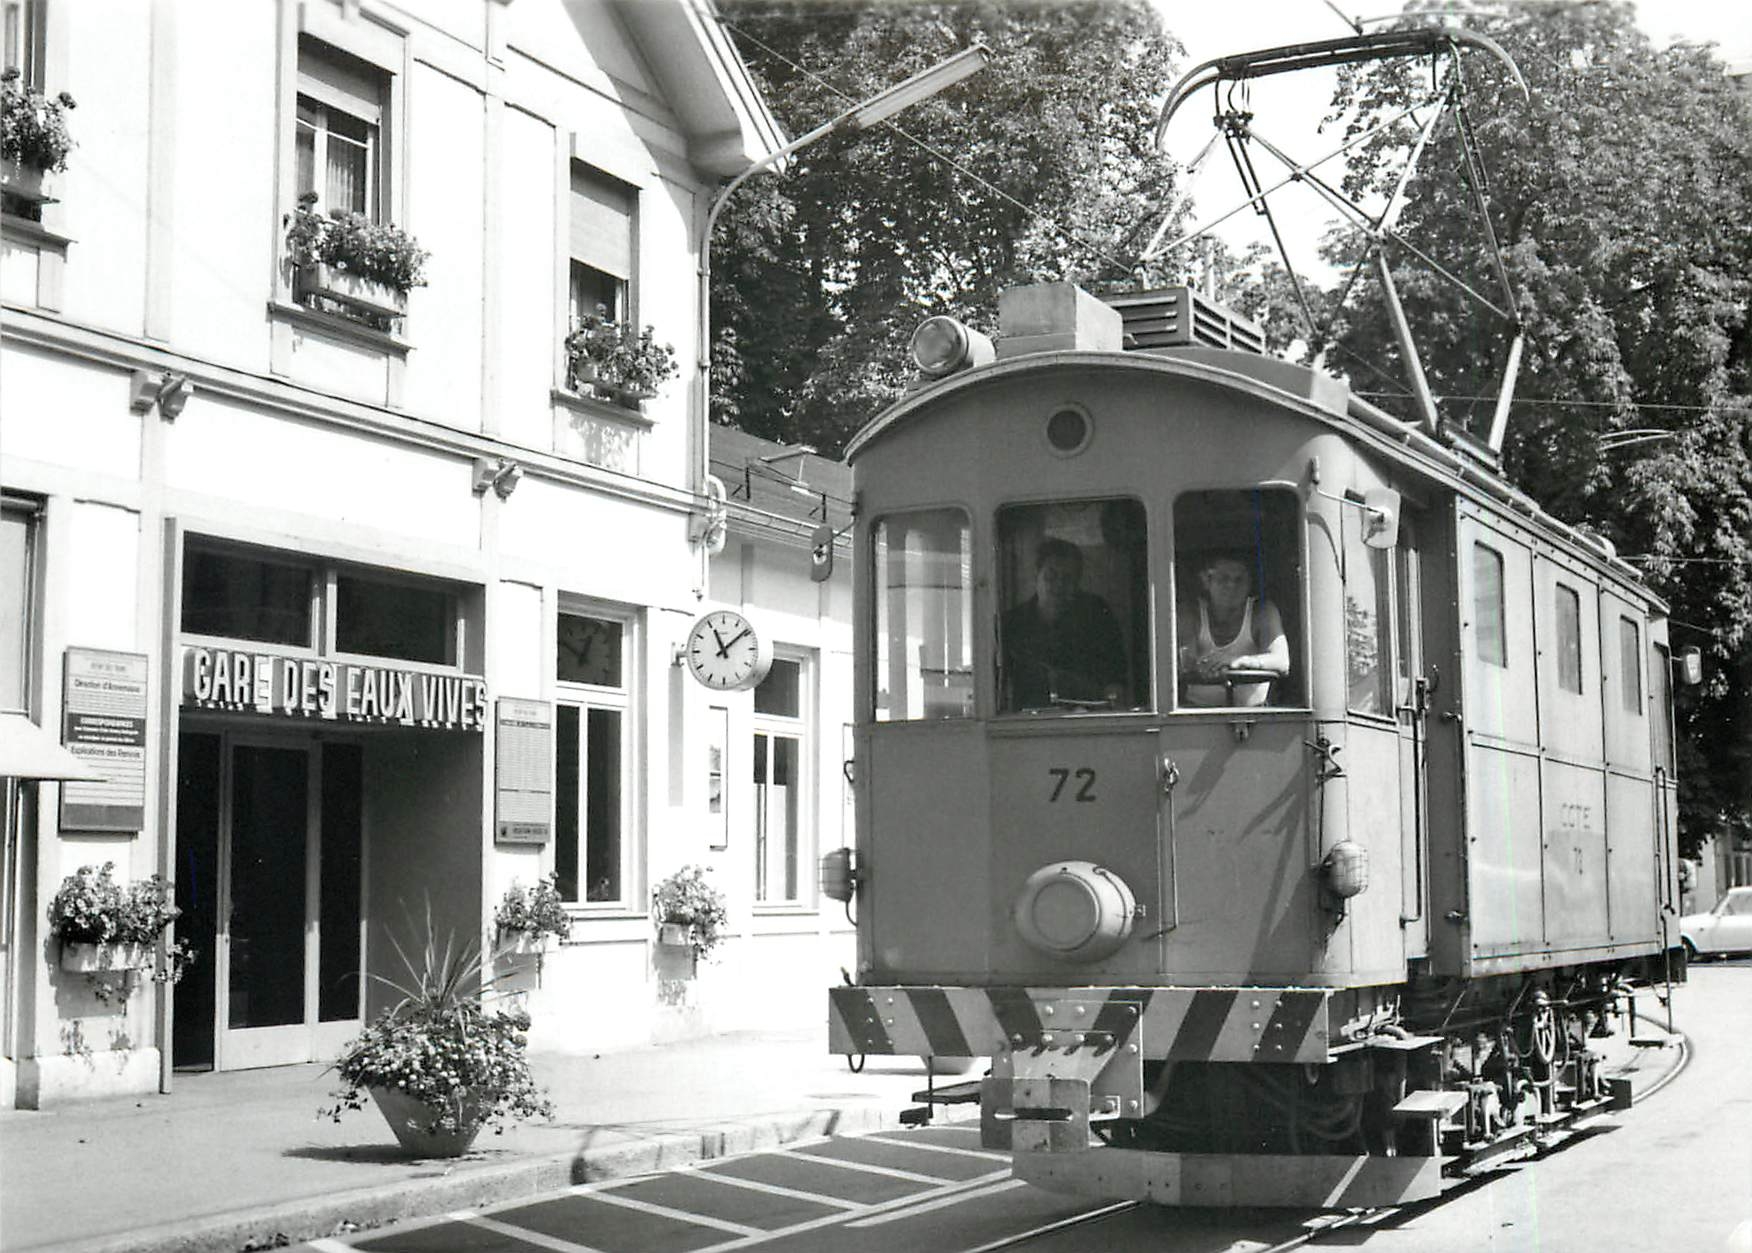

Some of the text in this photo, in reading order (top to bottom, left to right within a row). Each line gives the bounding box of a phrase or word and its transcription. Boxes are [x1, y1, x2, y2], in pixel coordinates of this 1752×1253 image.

[193, 648, 487, 731] GARE DES EAUX VIVES
[1049, 767, 1097, 803] 72
